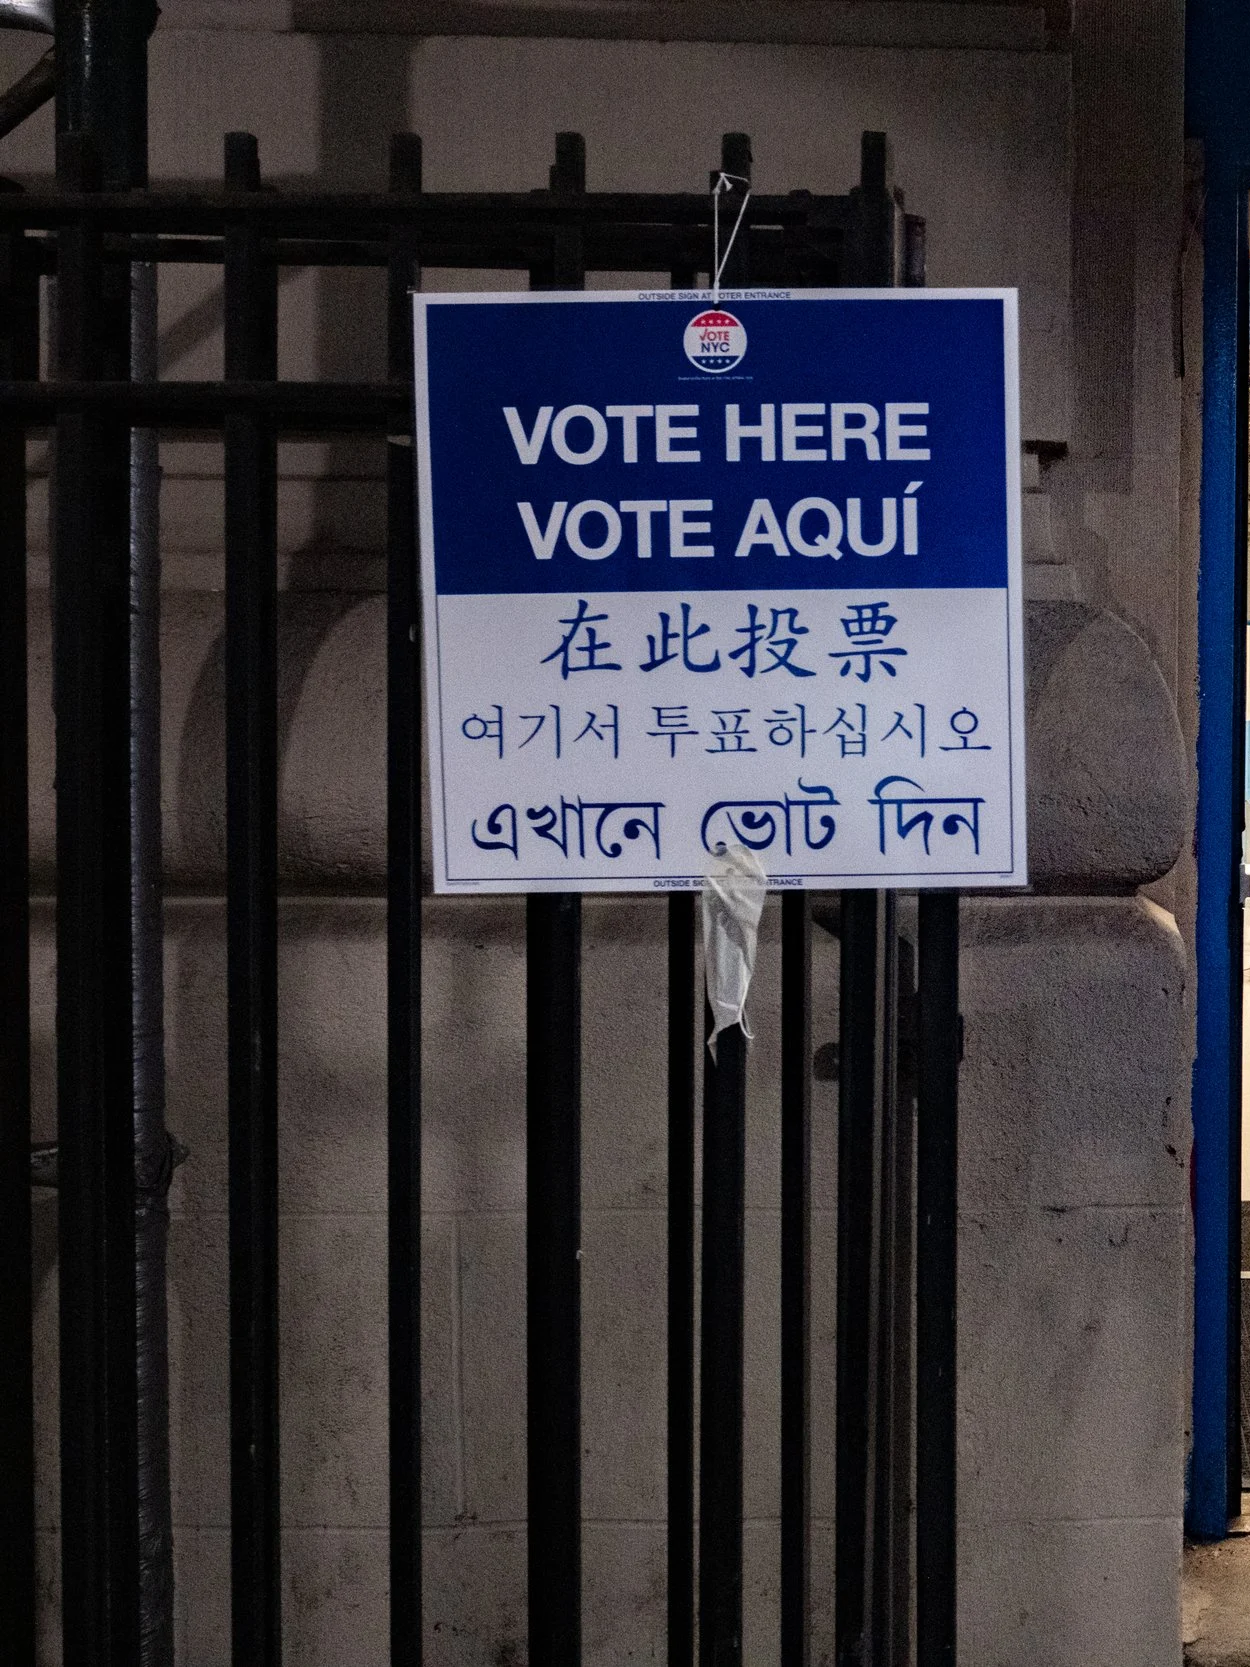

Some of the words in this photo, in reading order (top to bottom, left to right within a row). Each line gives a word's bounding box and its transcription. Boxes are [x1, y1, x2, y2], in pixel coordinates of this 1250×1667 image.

[638, 292, 676, 301] OUTSIDE
[678, 292, 699, 300] SIGN
[701, 292, 712, 300] AT
[717, 291, 742, 300] OTER
[744, 291, 791, 299] ENTRANCE
[699, 328, 730, 342] VOTE
[701, 342, 730, 353] NYC
[502, 403, 701, 465] VOTE
[725, 402, 931, 462] HERE
[516, 499, 715, 560] VOTE
[734, 481, 924, 560] AQUÍ
[539, 599, 908, 682] 在此投票
[461, 703, 620, 760] 여기서
[645, 702, 992, 759] 투표하십시오
[470, 795, 666, 860] এখানে
[700, 776, 841, 860] ভোট
[868, 775, 986, 859] দিন
[653, 879, 690, 888] OUTSIDE
